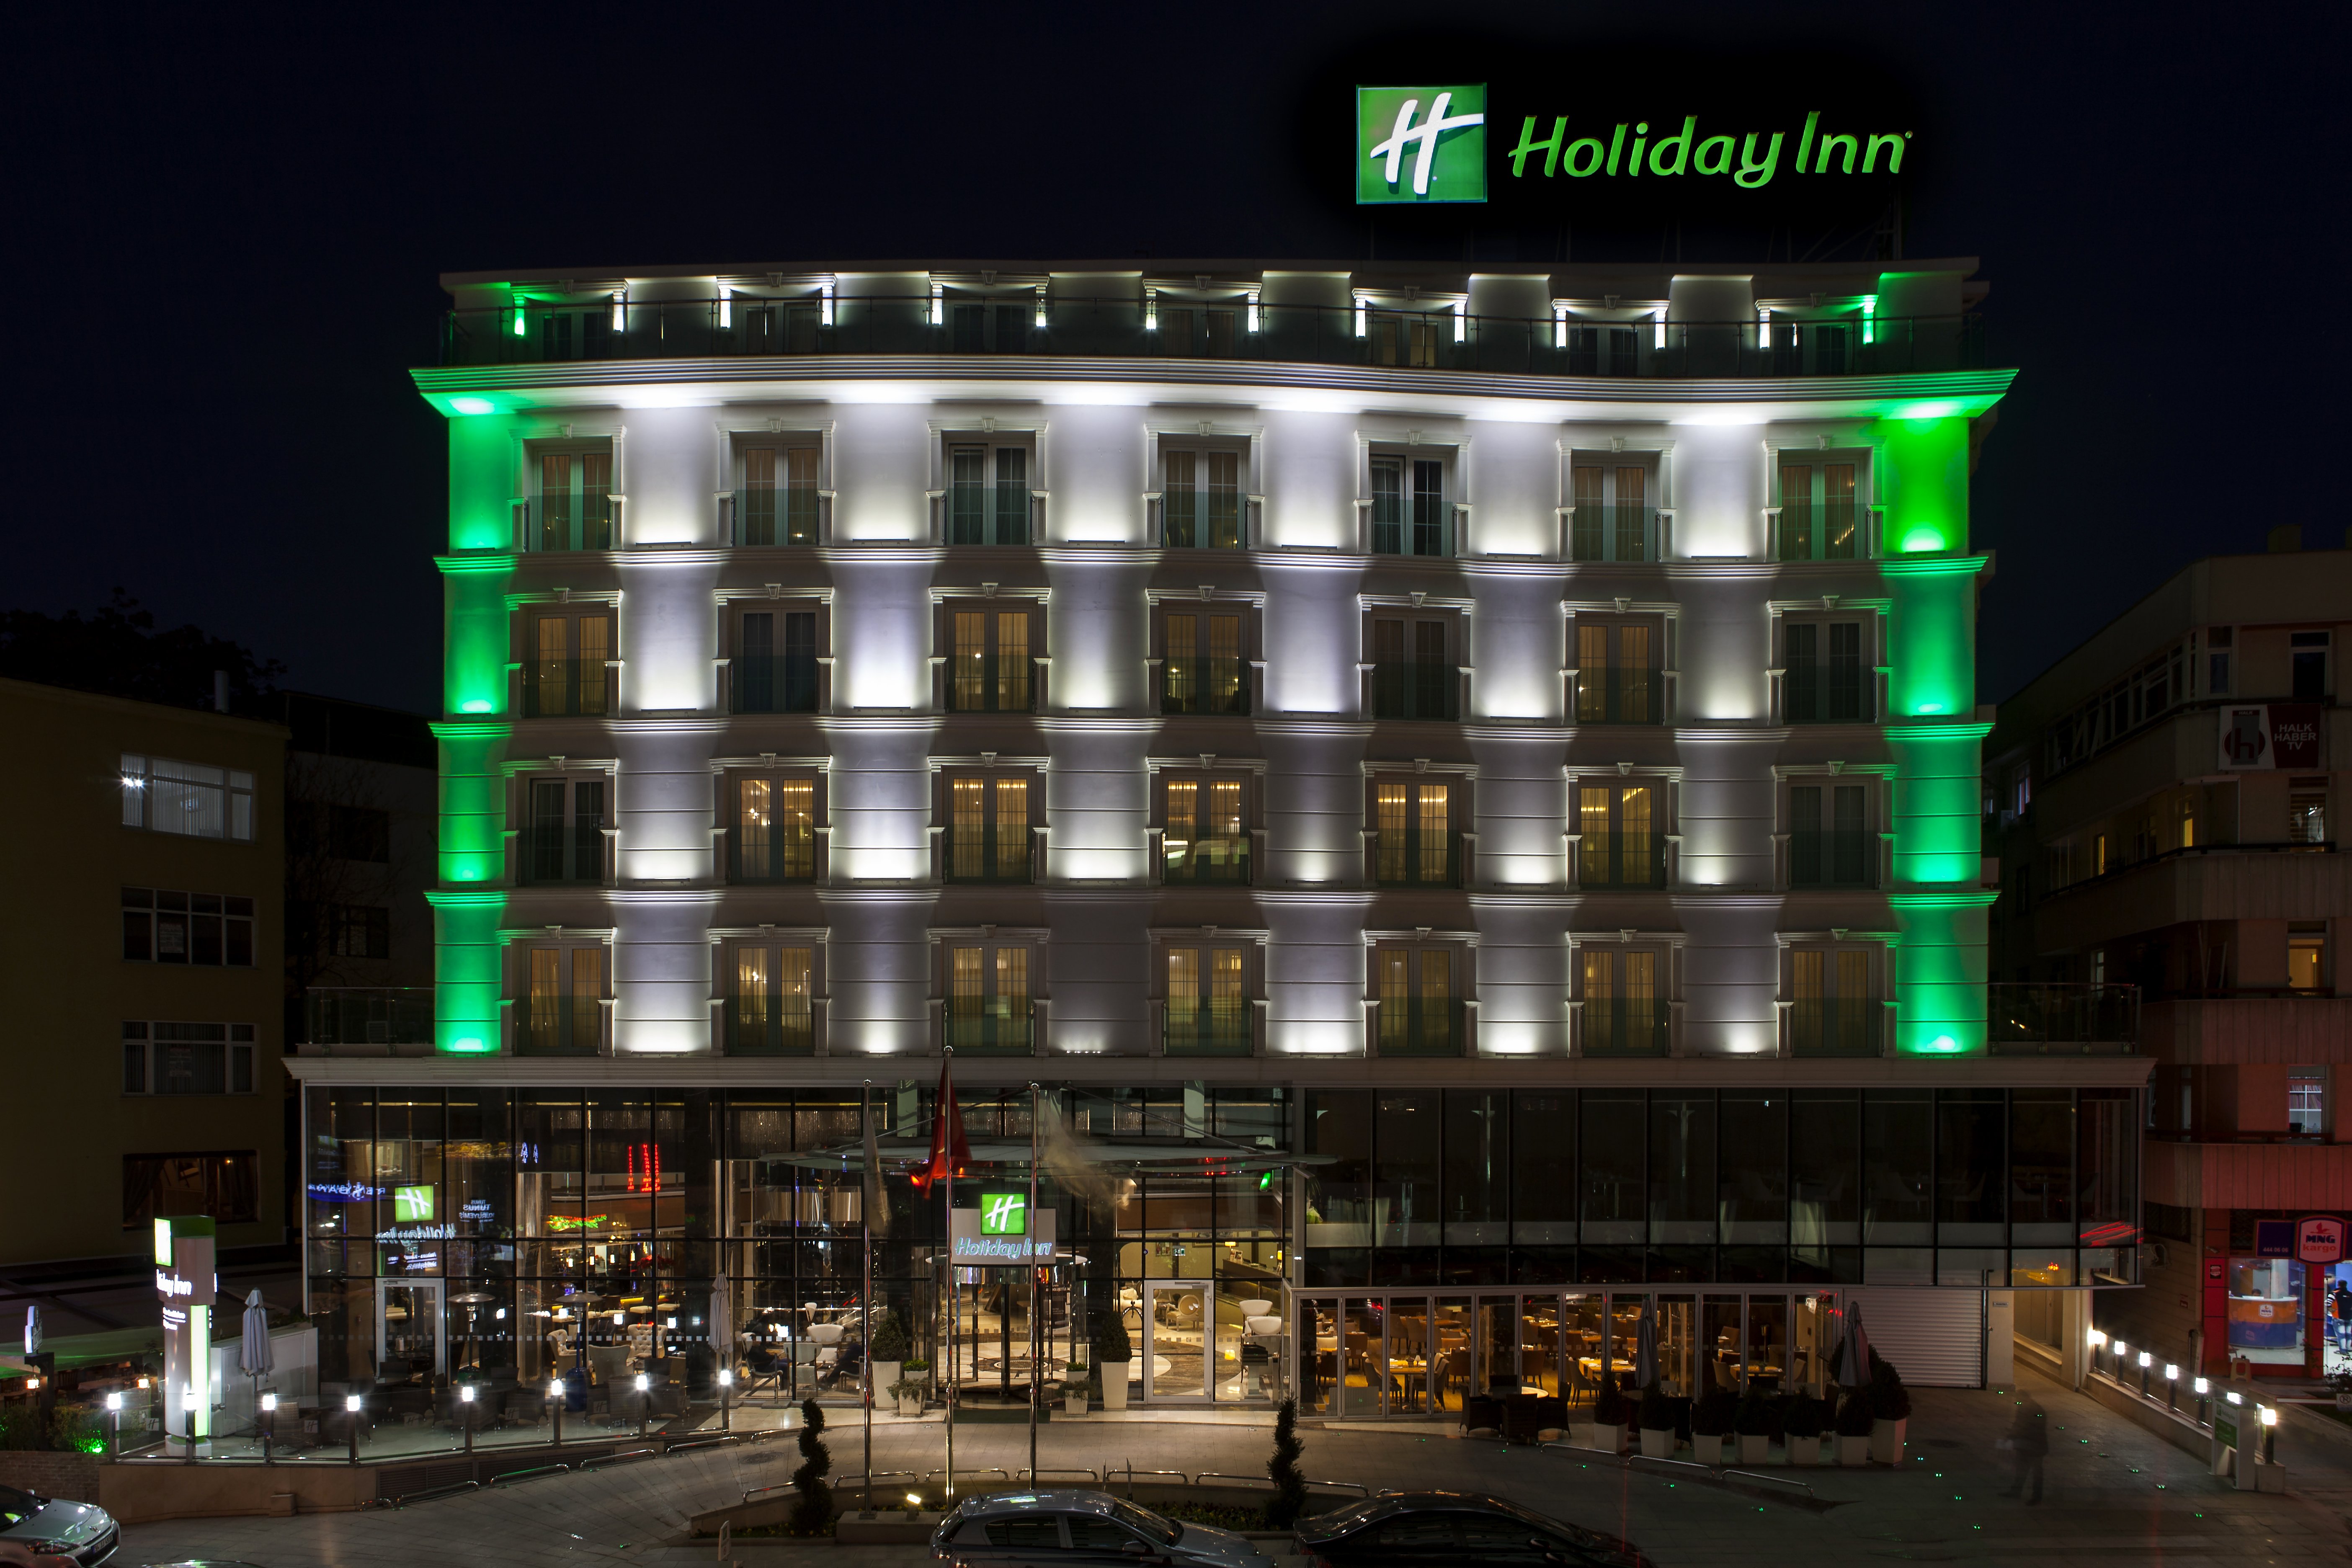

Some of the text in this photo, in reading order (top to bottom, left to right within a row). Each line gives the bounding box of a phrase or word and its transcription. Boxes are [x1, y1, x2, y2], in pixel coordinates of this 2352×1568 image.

[1508, 111, 1905, 188] Holiday Inn
[2279, 723, 2313, 732] HALK
[2274, 732, 2316, 742] HABER
[2287, 741, 2303, 751] TV
[955, 1238, 1050, 1259] Holiday Inn
[2303, 1244, 2337, 1253] kargo
[174, 1274, 192, 1295] Inn
